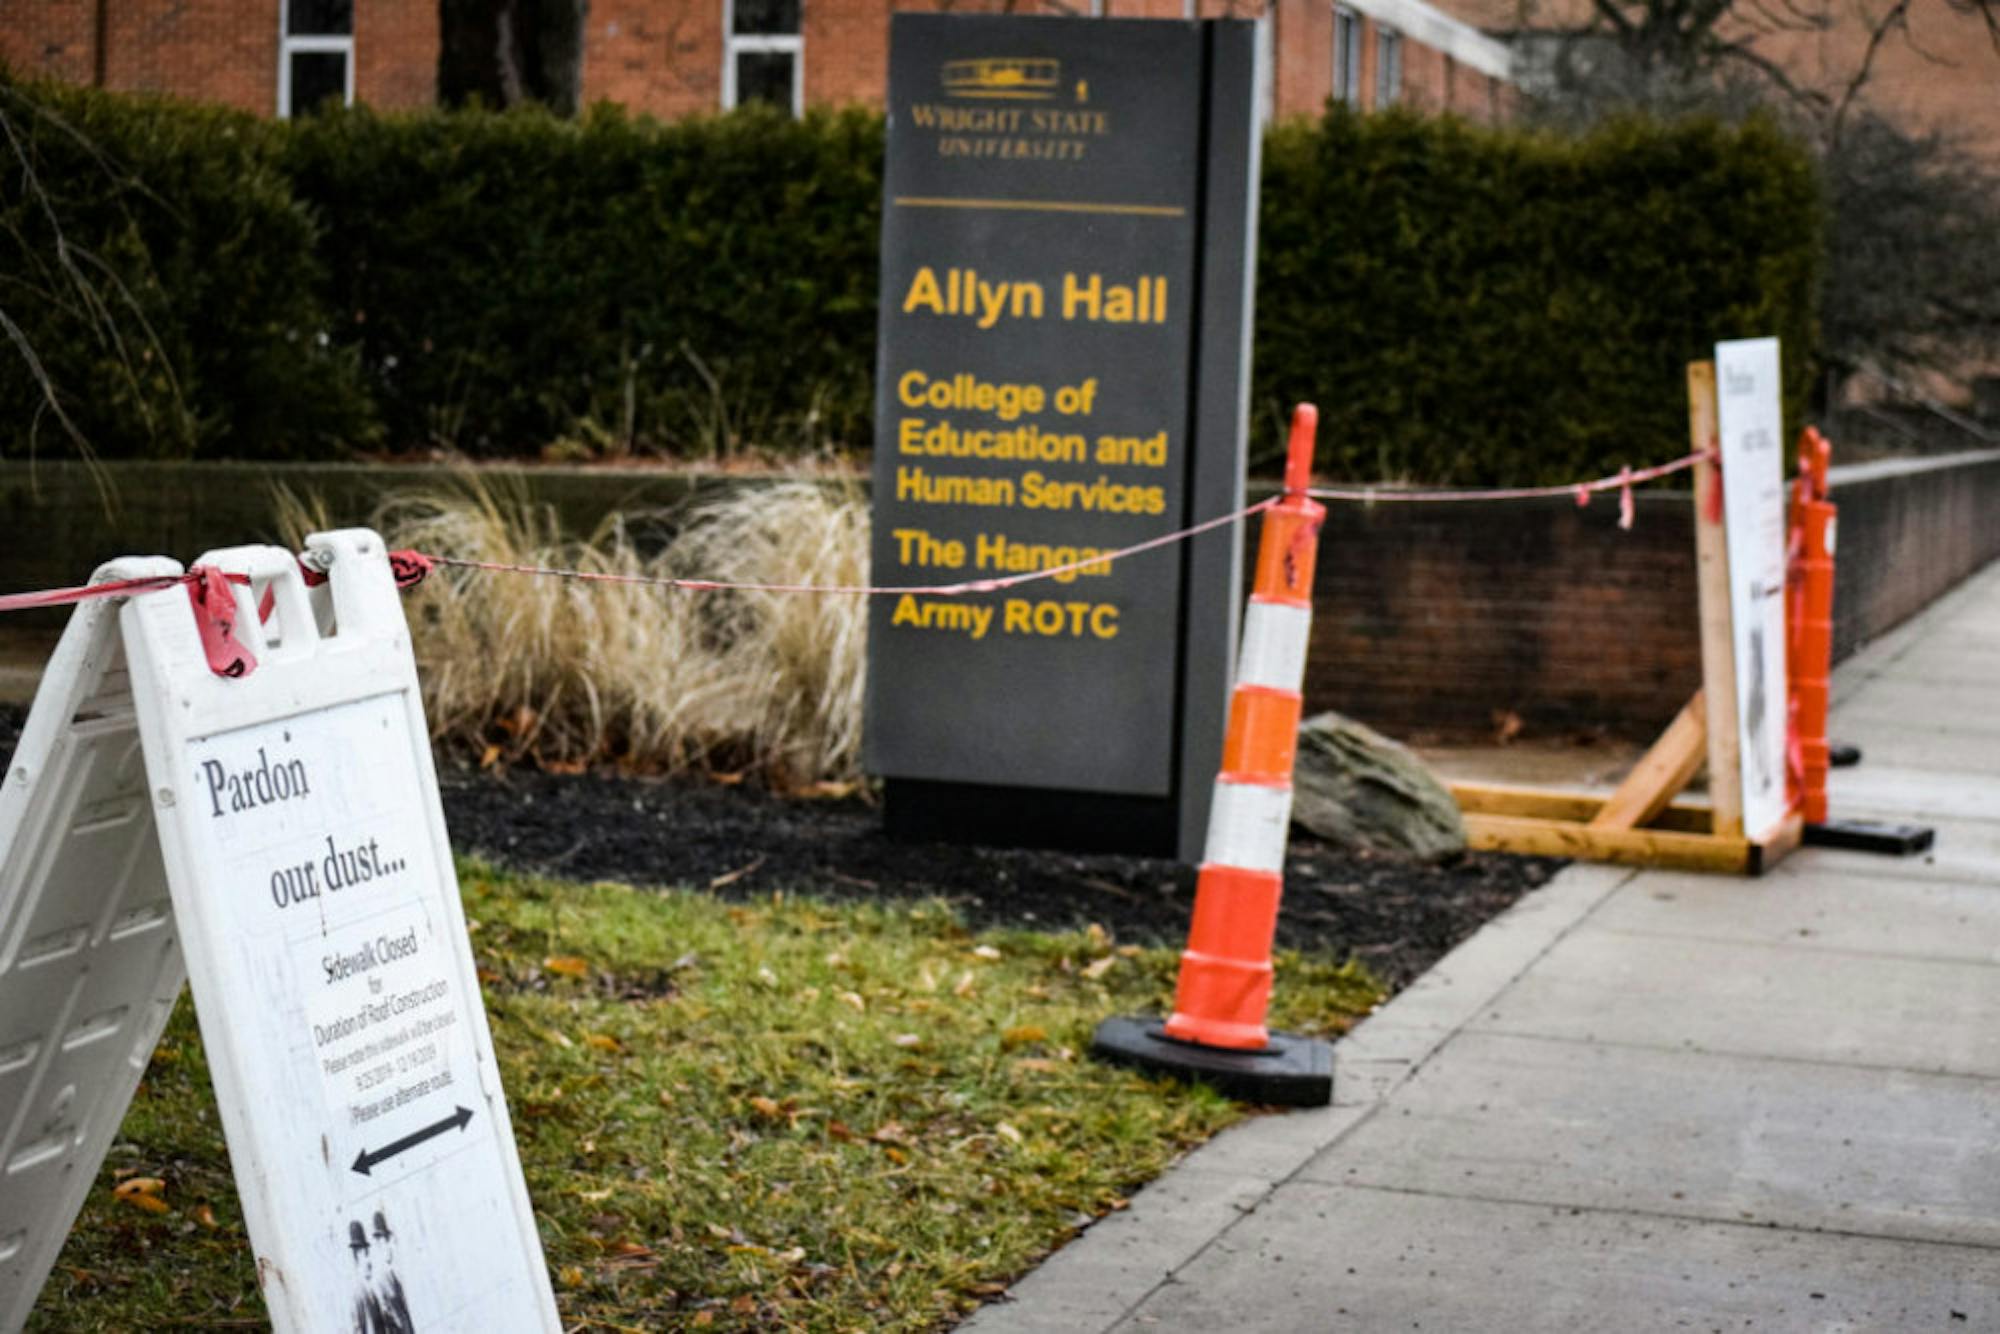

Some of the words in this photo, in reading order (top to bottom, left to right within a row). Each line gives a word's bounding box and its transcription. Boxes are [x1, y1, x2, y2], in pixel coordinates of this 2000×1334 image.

[912, 105, 1021, 133] WRIGHT
[1032, 110, 1110, 134] STATE
[938, 137, 1088, 160] UNIVERSITY
[903, 266, 1043, 329] Allyn
[1062, 272, 1168, 323] Hall
[898, 370, 1045, 420] College
[1055, 377, 1097, 415] of
[899, 419, 1086, 462] Education
[1096, 431, 1168, 467] and
[897, 466, 1014, 506] Human
[1021, 470, 1166, 515] Services
[893, 528, 965, 568] The
[976, 534, 1114, 583] Hangar
[892, 594, 994, 640] Army
[1004, 599, 1120, 638] ROTC
[202, 747, 310, 817] Pardon
[270, 861, 319, 909] our
[323, 835, 406, 892] dust...
[322, 941, 378, 984] Sidewalk
[377, 926, 418, 964] Closed
[368, 975, 382, 994] for
[313, 1014, 356, 1047] Duration
[356, 1006, 368, 1030] of
[368, 996, 389, 1023] Roof
[390, 979, 449, 1016] Construction
